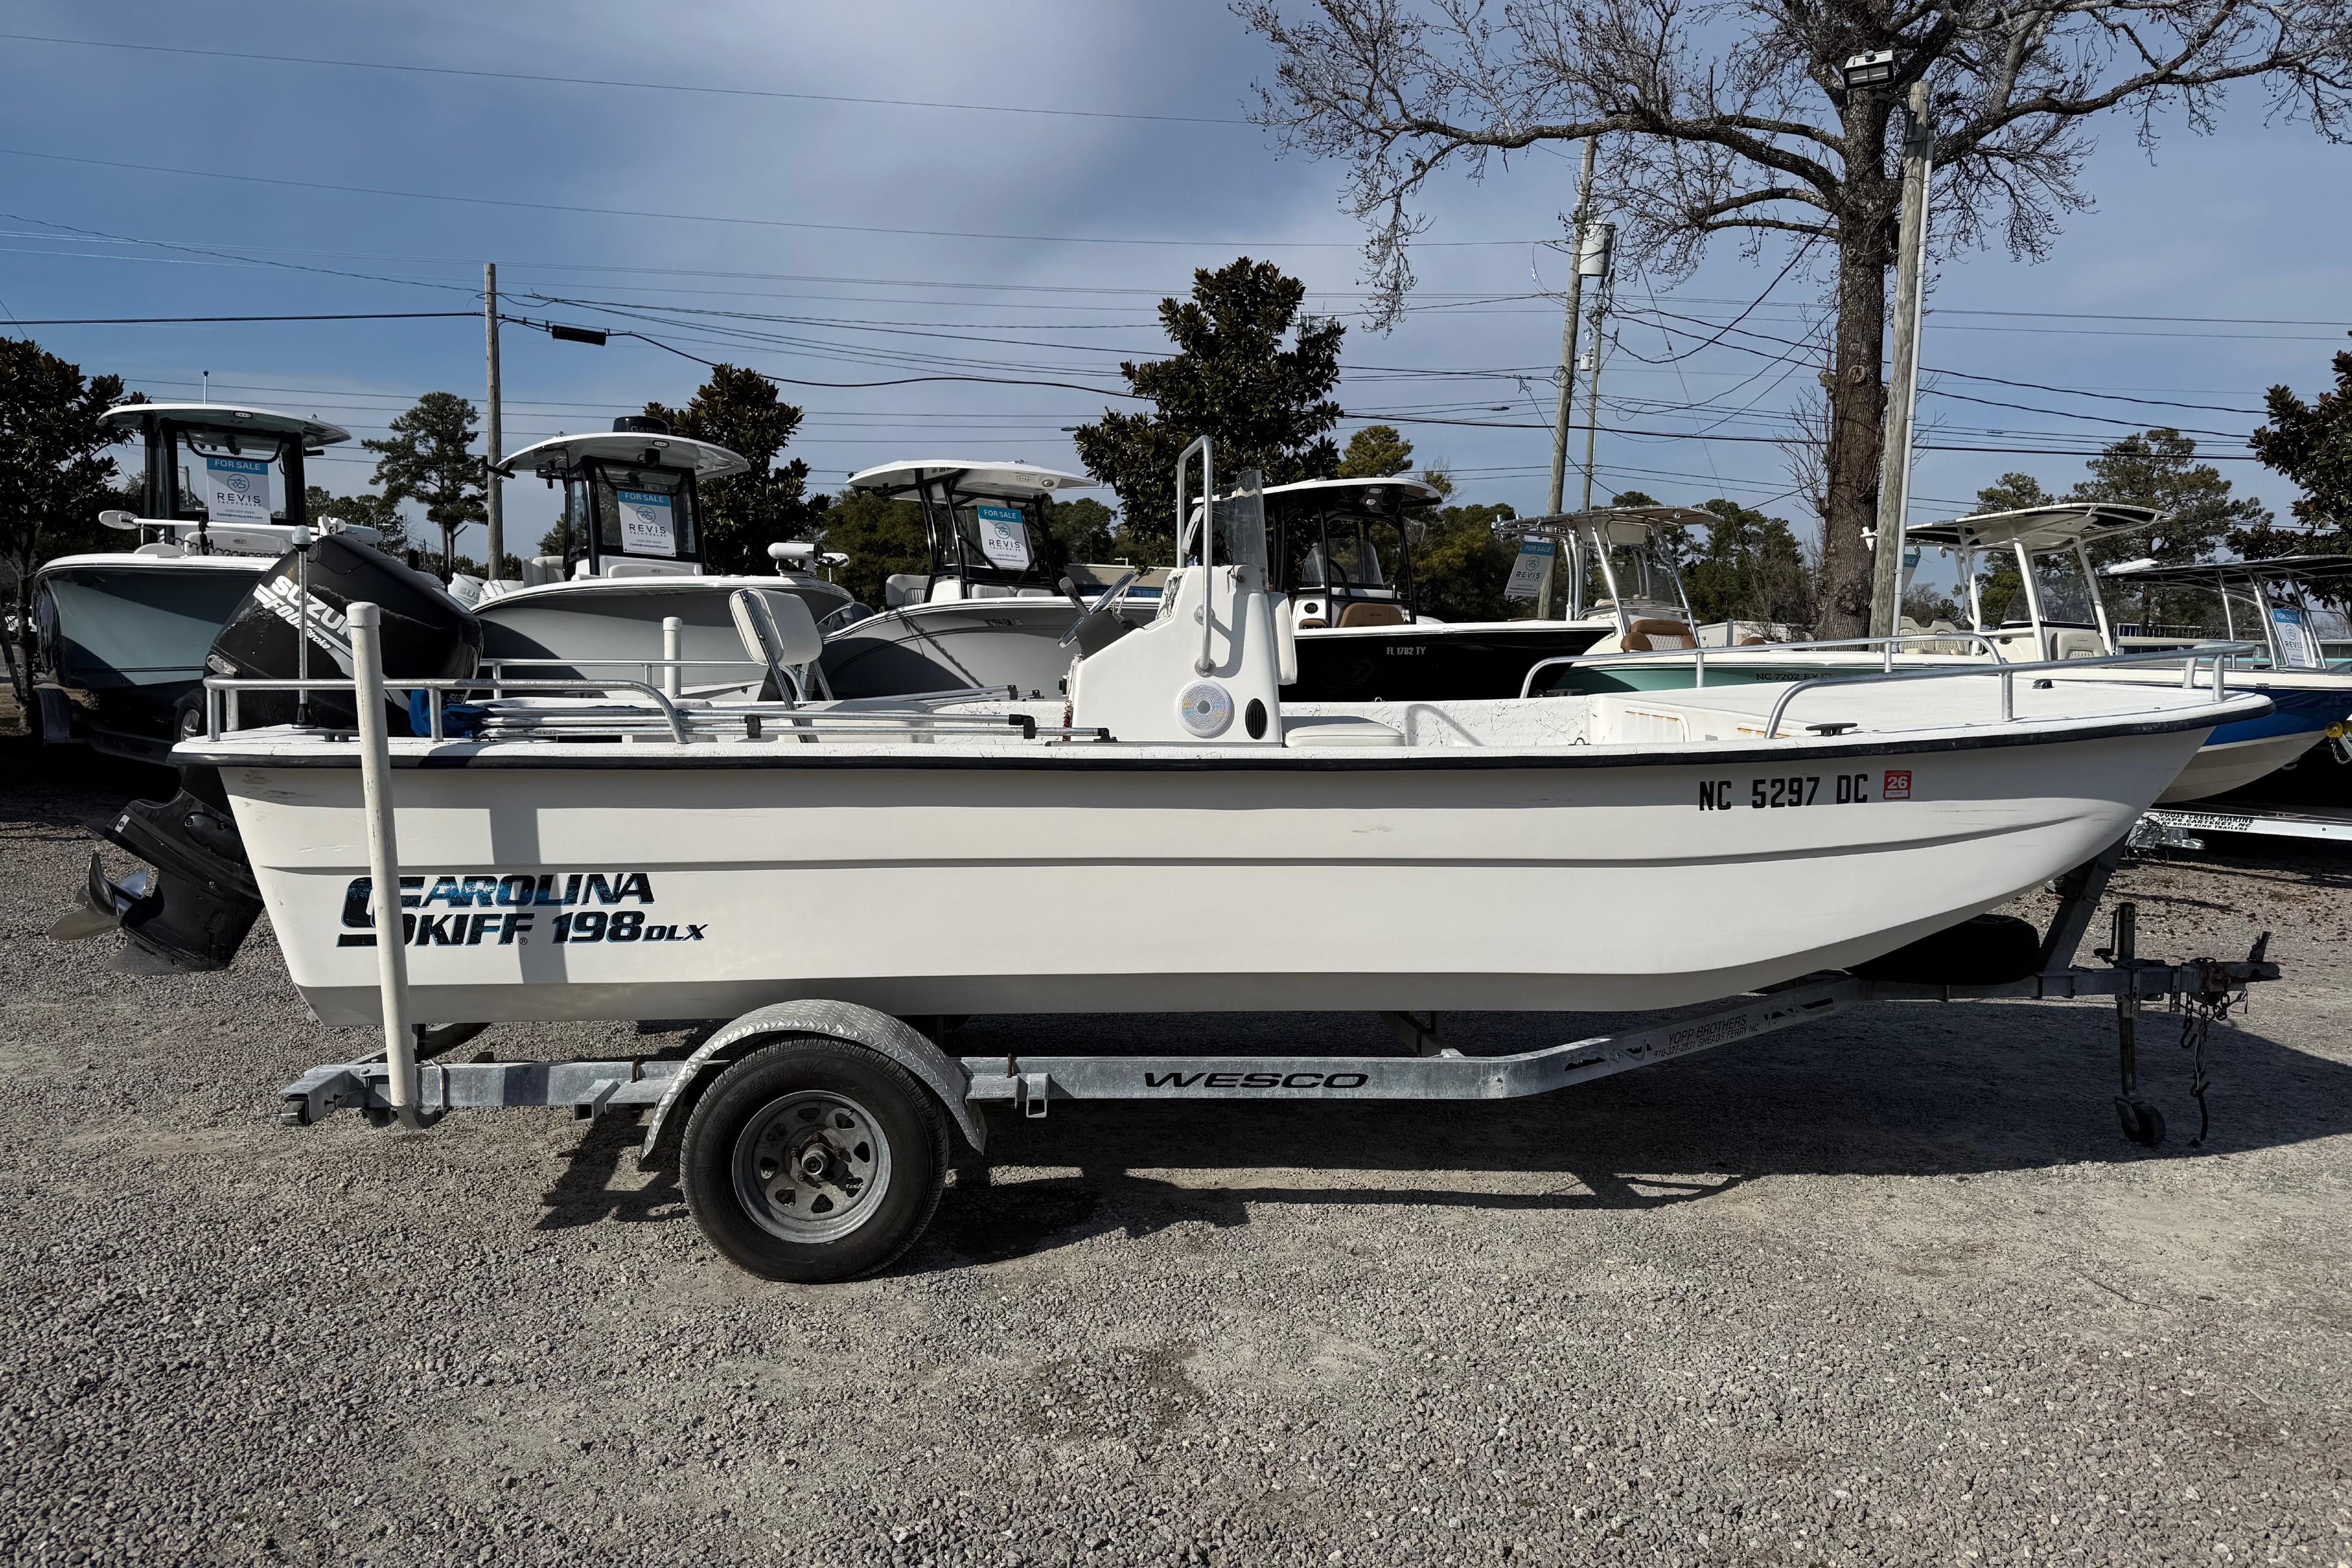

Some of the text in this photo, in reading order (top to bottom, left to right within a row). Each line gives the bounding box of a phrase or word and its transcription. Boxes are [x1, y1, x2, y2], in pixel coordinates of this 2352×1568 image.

[631, 426, 666, 435] GARMI
[215, 459, 261, 470] FOR SALE
[217, 492, 261, 503] REVIS
[625, 492, 664, 503] FOR SALE
[629, 523, 666, 534] REVIS
[989, 539, 1020, 548] REVIS
[271, 575, 352, 641] SUZUK
[1386, 646, 1426, 655] FL 1782 TY
[1887, 776, 1908, 789] 26
[1699, 774, 1868, 811] NC 5297 DC
[2188, 813, 2215, 821] CREEK
[2218, 815, 2254, 824] MARINE
[341, 873, 655, 910] CAROLINA
[552, 910, 646, 944] 198
[642, 923, 709, 942] DLX
[1669, 1014, 1747, 1046] YOPP BROTHERS
[1654, 1023, 1759, 1059] 910-327-2831 SNEADS FERRY NC
[1144, 1072, 1369, 1088] WESCO
